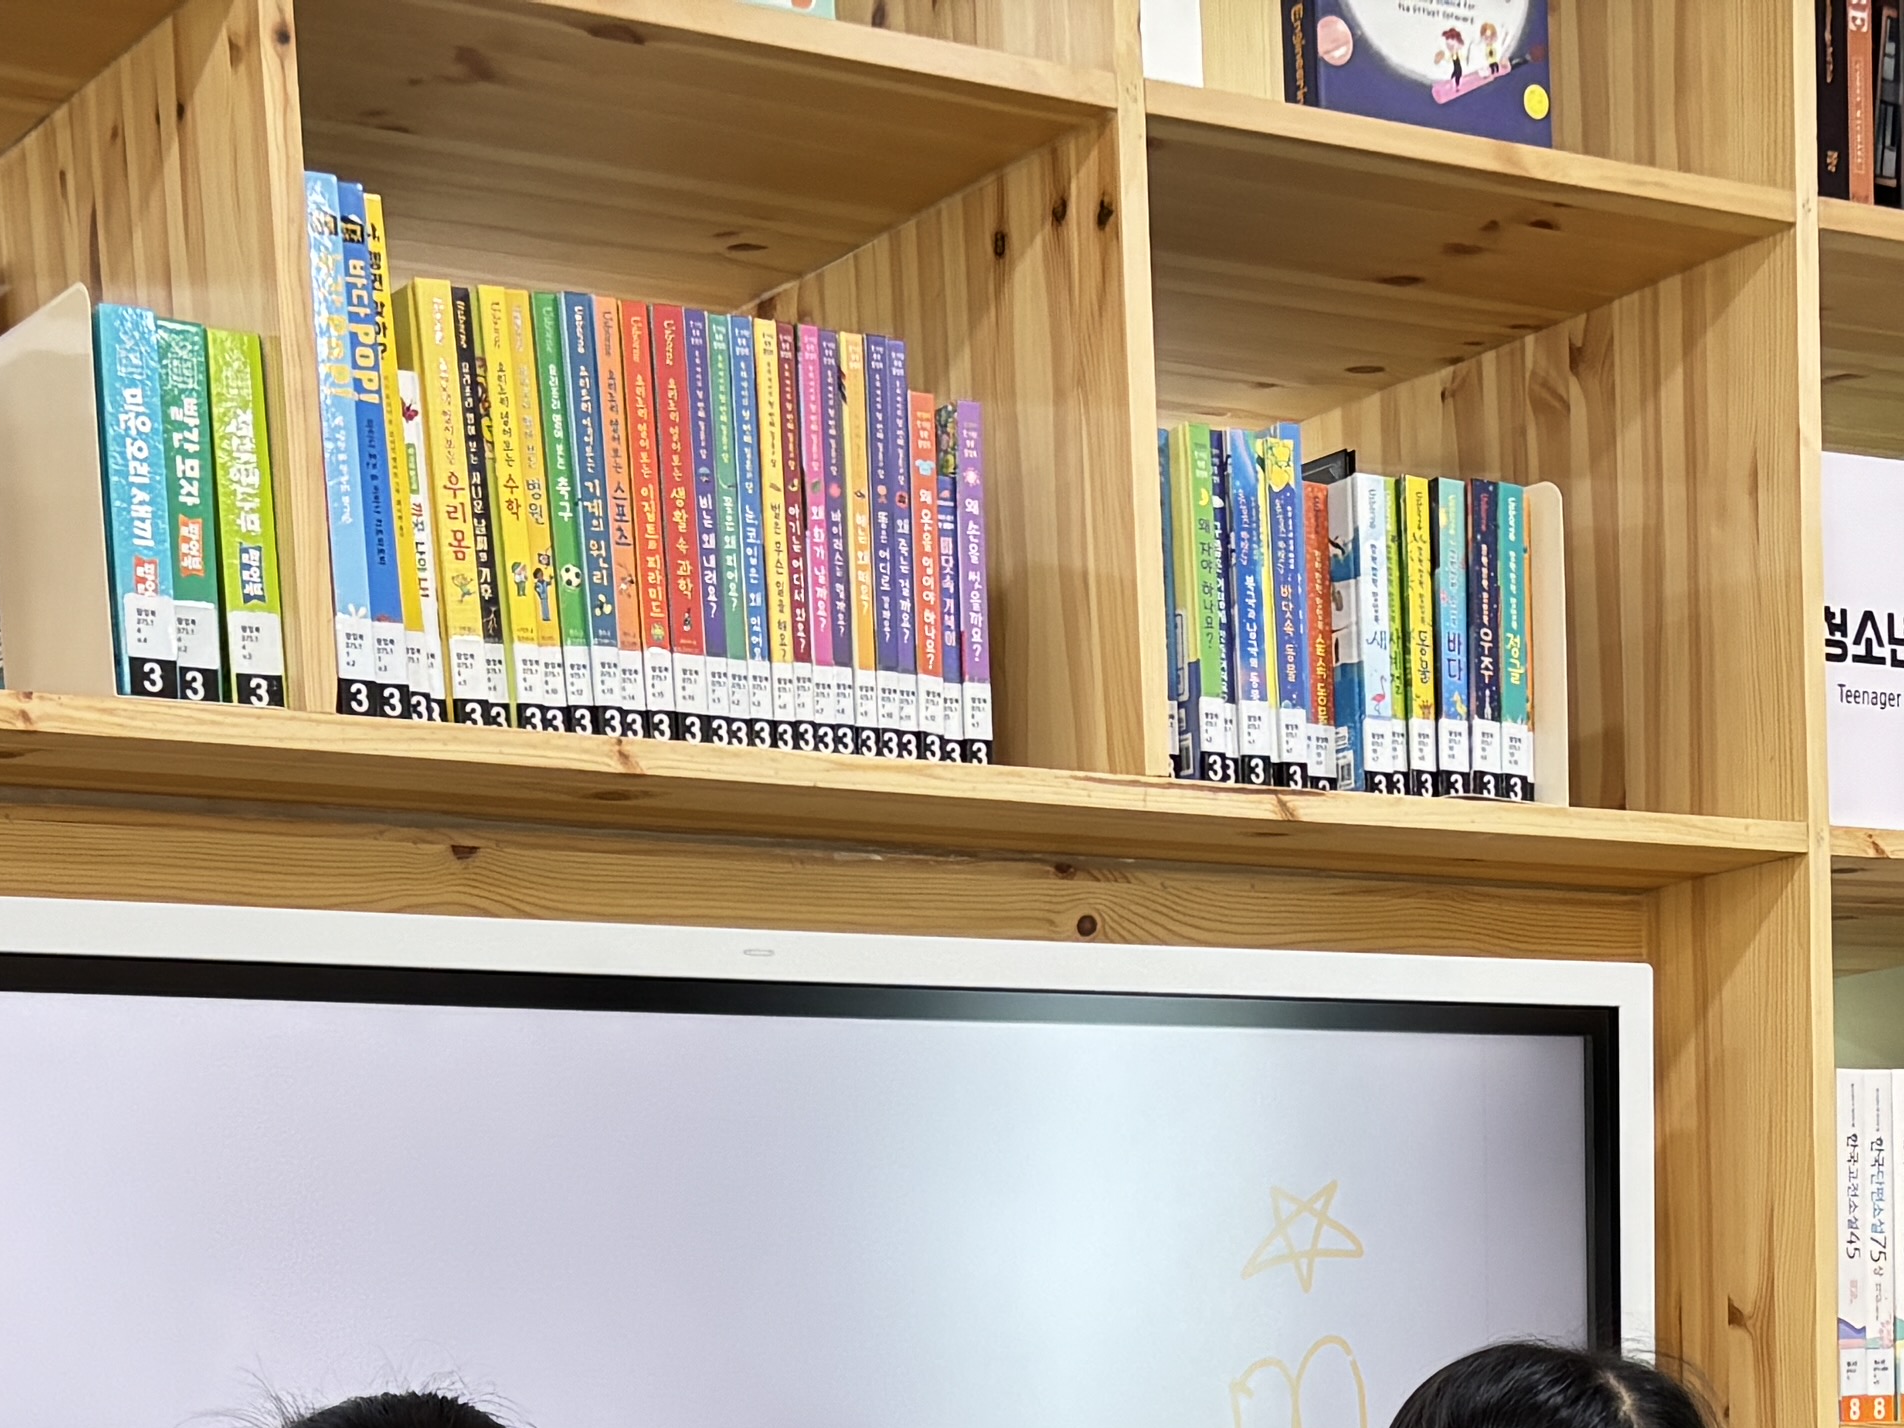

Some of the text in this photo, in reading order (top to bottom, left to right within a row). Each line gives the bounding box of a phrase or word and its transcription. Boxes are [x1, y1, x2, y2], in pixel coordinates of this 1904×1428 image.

[125, 438, 152, 484] 오리
[170, 397, 201, 506] 빨간 모자
[130, 486, 156, 547] 새끼
[443, 472, 471, 562] 우리 몸
[555, 476, 574, 523] 축구
[613, 483, 633, 548] 스포츠
[964, 498, 980, 515] 왜
[702, 534, 716, 549] 왜
[966, 519, 981, 565] 손을
[703, 555, 718, 618] 내려요?
[923, 610, 937, 669] 하나요?
[1446, 631, 1464, 682] 바다
[1479, 630, 1495, 685] 우주
[1505, 632, 1525, 686] 정글
[142, 661, 164, 693] 3
[1837, 683, 1902, 710] Teenager
